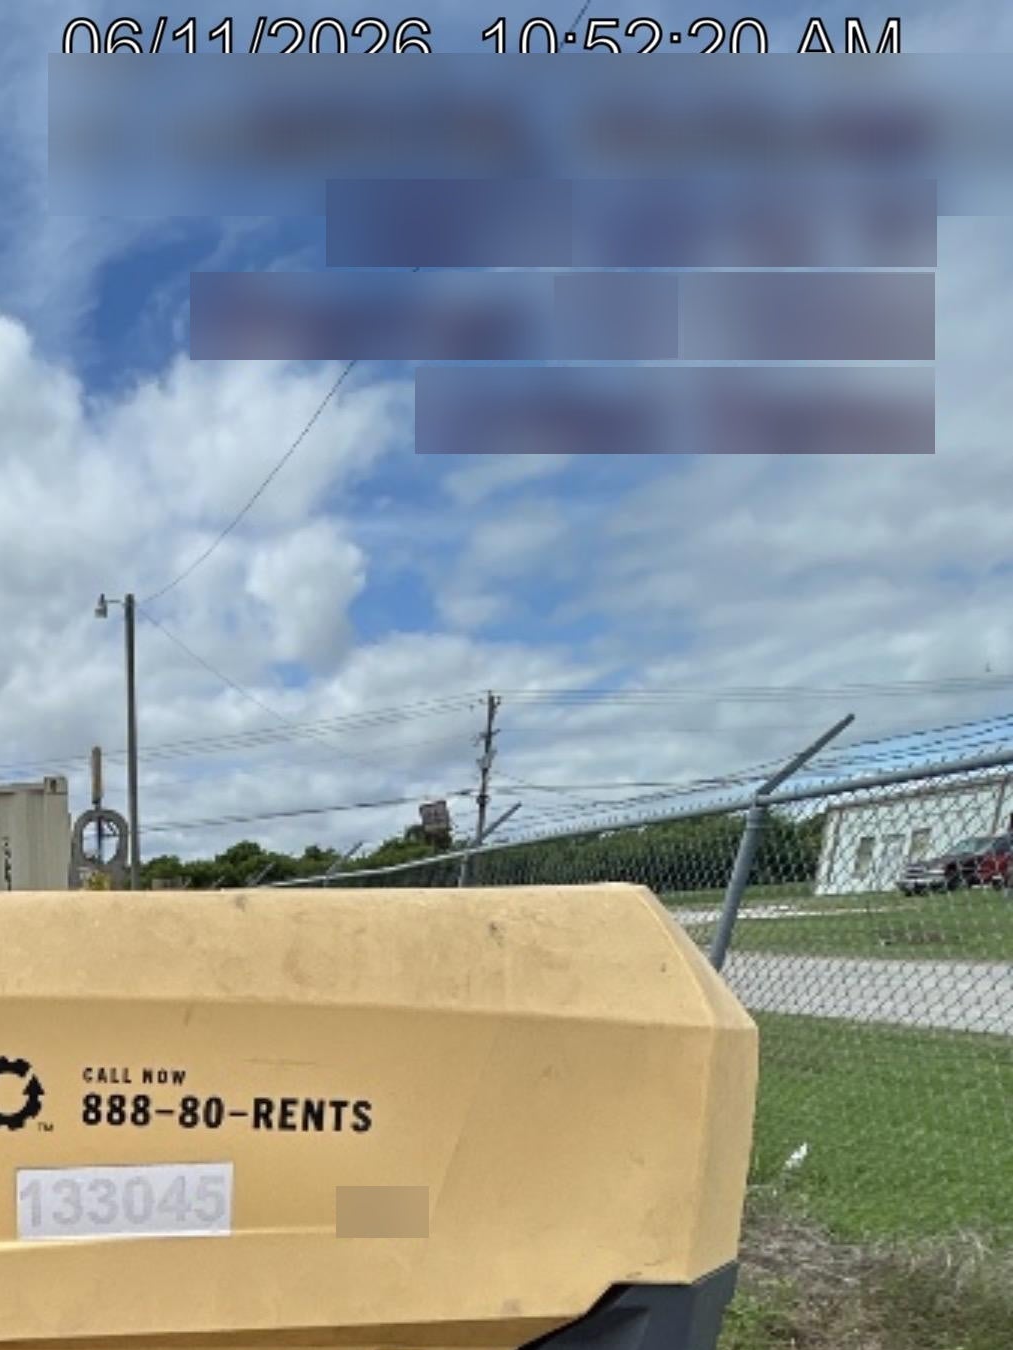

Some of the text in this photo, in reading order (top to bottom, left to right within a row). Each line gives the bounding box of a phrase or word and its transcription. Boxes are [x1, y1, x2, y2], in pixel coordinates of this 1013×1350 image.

[82, 1067, 187, 1086] CALL NOW
[82, 1093, 372, 1133] 888-80-RENTS
[19, 1174, 227, 1228] 133045
